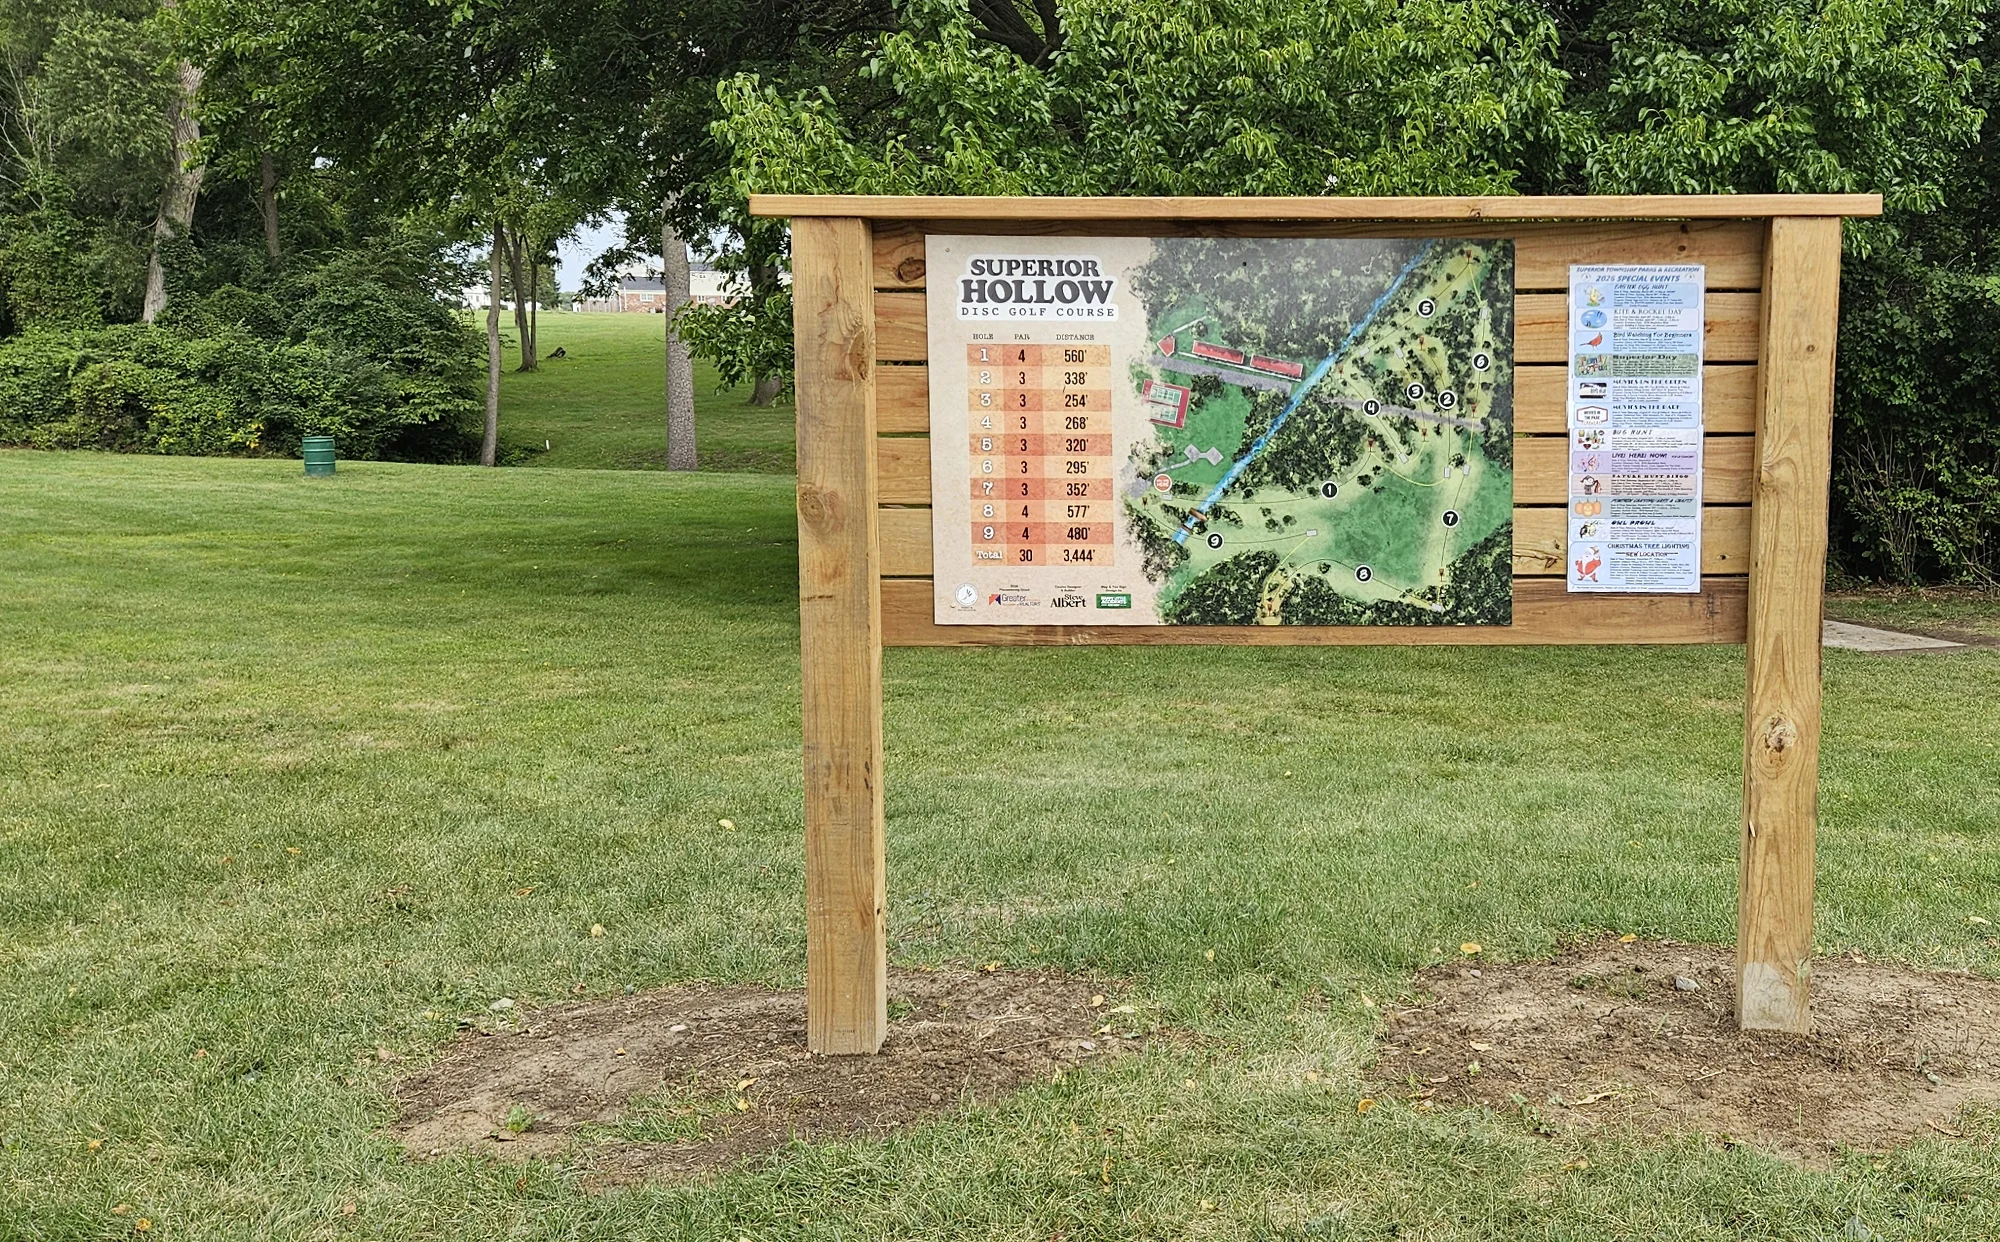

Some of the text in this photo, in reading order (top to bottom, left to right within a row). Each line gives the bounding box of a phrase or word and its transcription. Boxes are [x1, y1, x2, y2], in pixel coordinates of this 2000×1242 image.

[971, 259, 1100, 276] SUPERIOR
[961, 280, 1113, 304] HOLLOW
[962, 308, 1114, 316] DISC GOLF COURSE
[980, 349, 989, 361] 1
[1018, 350, 1025, 362] 4
[980, 371, 990, 384] 2
[1019, 372, 1025, 384] 3
[980, 394, 991, 406] 3
[1020, 394, 1026, 407] 3
[981, 416, 992, 428] 4
[1020, 417, 1026, 429] 3
[981, 438, 992, 450] 5
[1021, 439, 1027, 451] 3
[982, 460, 993, 473] 6
[1021, 461, 1027, 473] 3
[982, 482, 993, 495] 7
[1022, 483, 1028, 496] 3
[983, 505, 994, 518] 8
[1022, 505, 1028, 518] 4
[983, 526, 994, 539] 9
[1022, 527, 1029, 540] 4
[976, 550, 1003, 559] Total
[1020, 550, 1032, 562] 30
[1050, 598, 1086, 608] Albert
